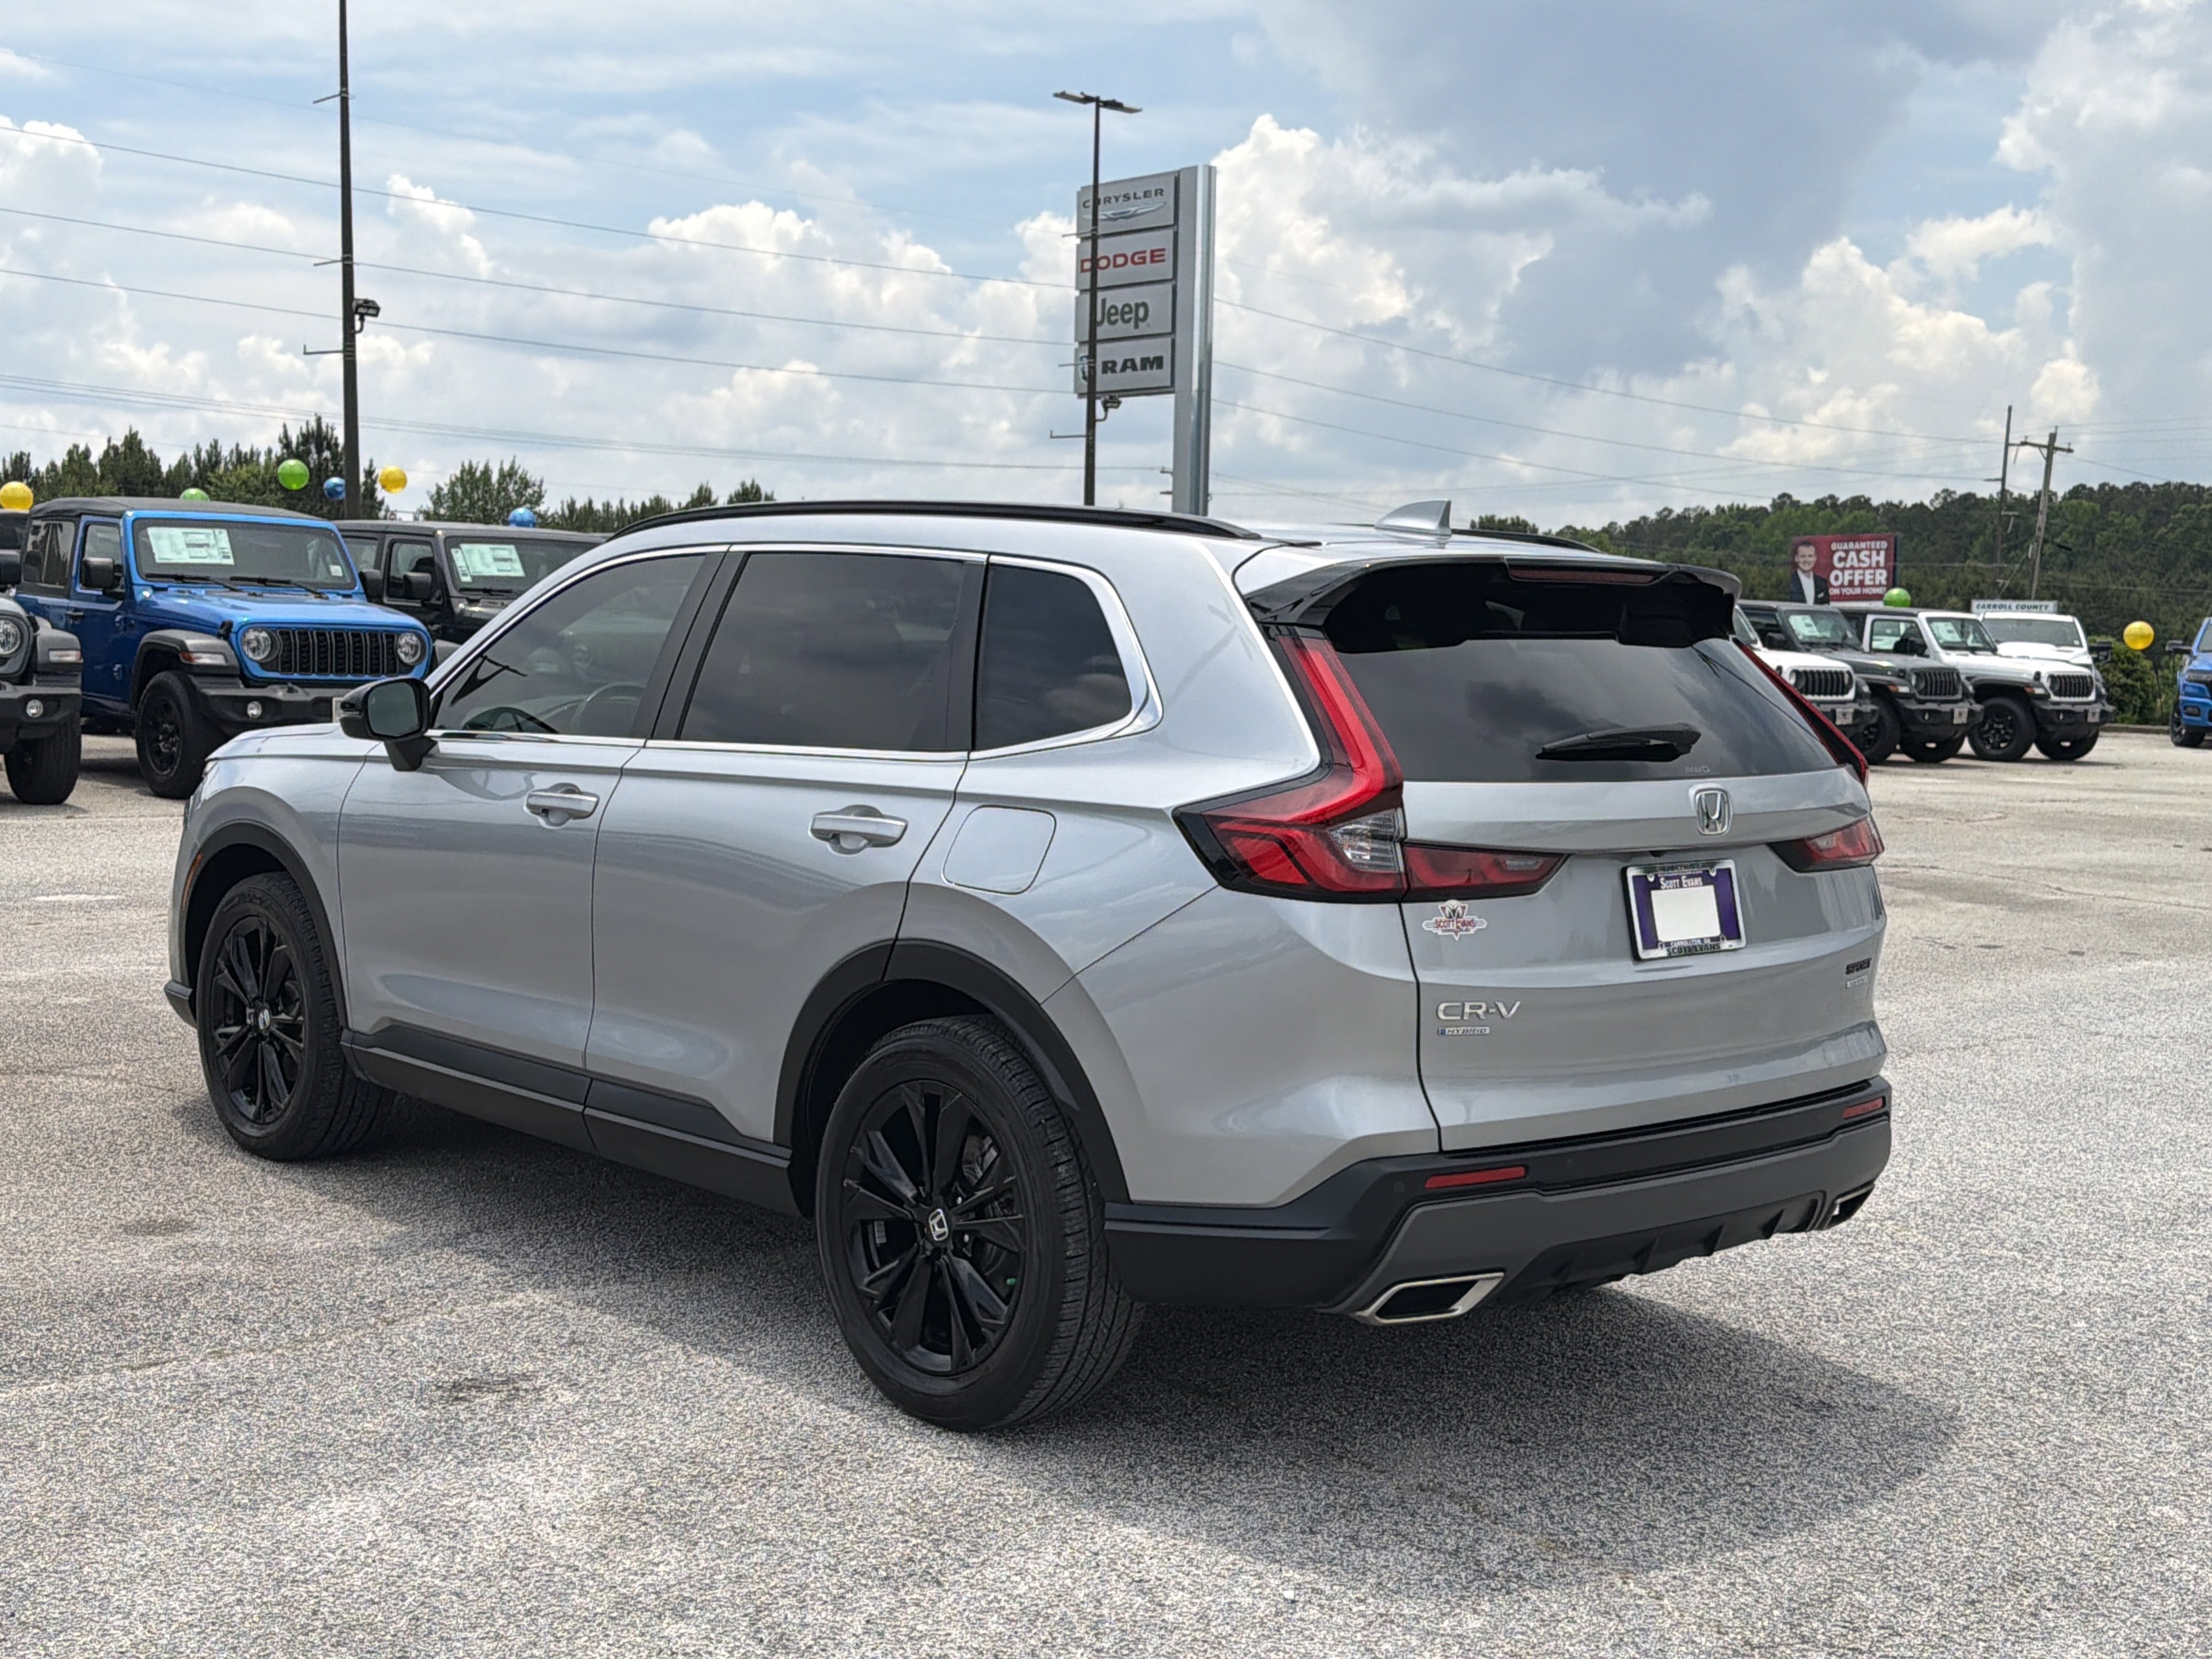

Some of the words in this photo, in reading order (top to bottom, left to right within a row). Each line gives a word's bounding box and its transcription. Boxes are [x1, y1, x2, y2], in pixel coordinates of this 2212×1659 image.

[1080, 247, 1166, 273] DODGE
[1096, 297, 1149, 330] Jeep
[1101, 356, 1164, 374] RAM
[1830, 540, 1888, 551] GUARANTEED
[1832, 550, 1886, 568] CASH
[1829, 569, 1888, 586] OFFER
[1829, 587, 1840, 596] ON
[1841, 587, 1861, 596] YOUR
[1435, 918, 1454, 928] SCOTT
[1437, 1001, 1521, 1020] CR-V
